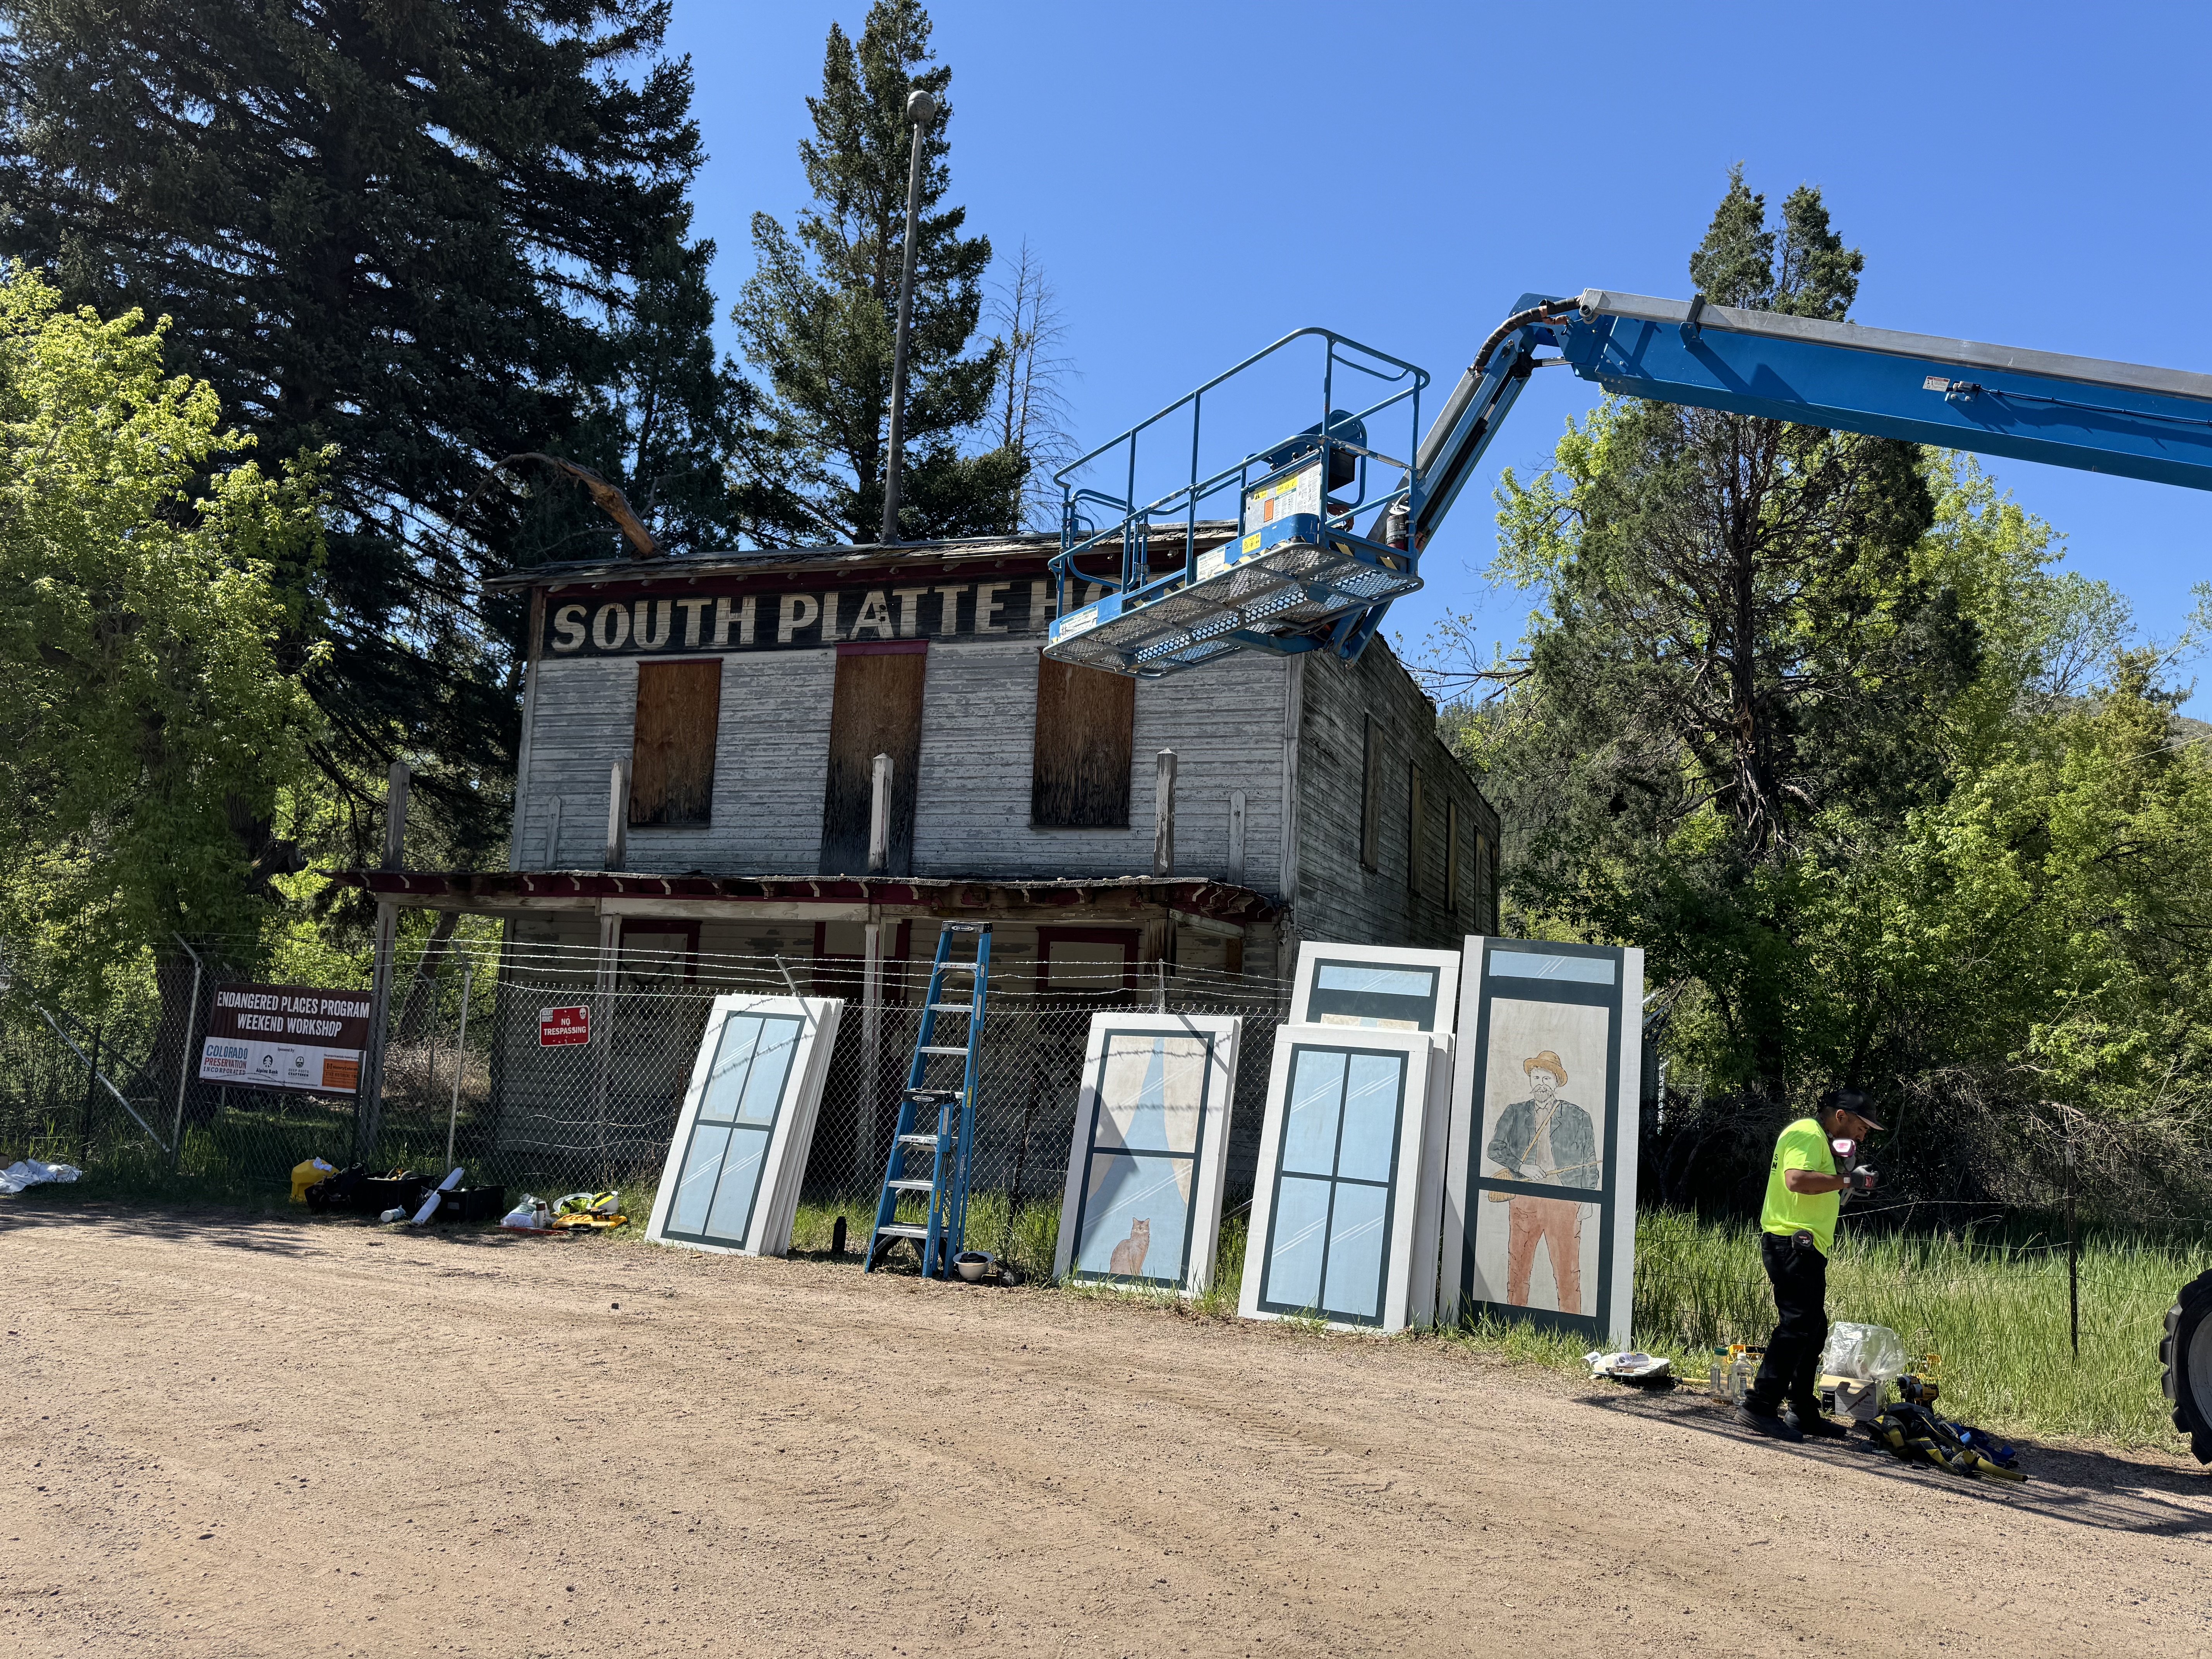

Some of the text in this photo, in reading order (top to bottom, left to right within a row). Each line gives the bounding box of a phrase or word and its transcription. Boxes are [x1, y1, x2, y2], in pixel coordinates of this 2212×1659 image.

[551, 595, 757, 653] SOUTH
[778, 582, 1011, 643] PLATTE
[217, 991, 370, 1018] ENDANGERED PLACES PROGRAM
[238, 1013, 342, 1037] WEEKEND WORKSHOP
[561, 1018, 570, 1026] NO
[544, 1026, 586, 1036] TRESPASSING
[206, 1045, 248, 1060] COLORADO
[204, 1057, 247, 1069] PRESERVATION
[203, 1066, 246, 1075] INCORPORATED
